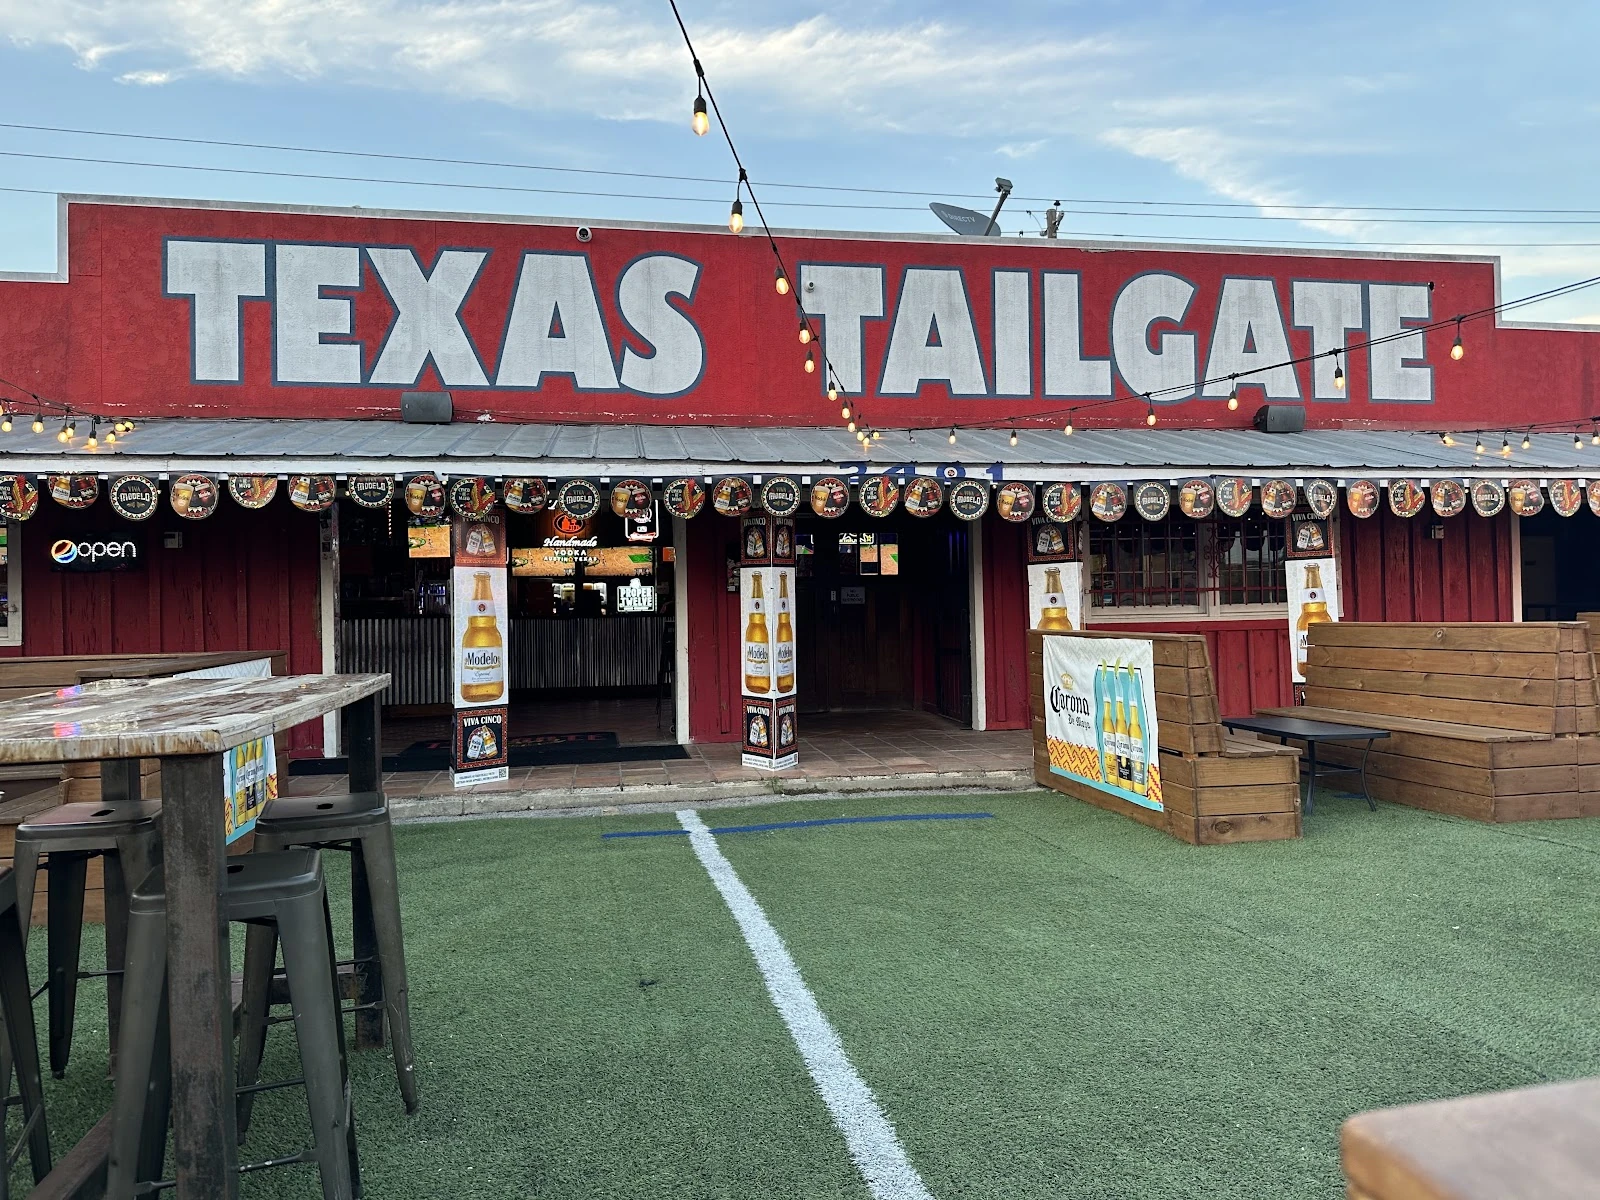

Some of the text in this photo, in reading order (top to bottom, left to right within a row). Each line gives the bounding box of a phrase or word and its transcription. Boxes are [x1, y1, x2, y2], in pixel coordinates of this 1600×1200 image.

[163, 238, 705, 396] TEXAS
[798, 261, 1435, 404] TAILGATE
[356, 482, 386, 492] MODELO
[119, 492, 150, 502] MODELO
[566, 495, 593, 504] MODELO
[768, 492, 793, 502] MODELO
[956, 495, 980, 505] MODELO
[1031, 516, 1046, 526] VIVA
[1291, 513, 1306, 522] VIVA
[543, 535, 598, 548] Handmade
[77, 541, 137, 562] open
[620, 587, 653, 598] PROPER
[619, 597, 653, 608] TWELVE
[747, 645, 769, 660] Modelo
[466, 651, 498, 666] Modelo
[1050, 684, 1090, 718] Corona
[463, 714, 502, 728] VIVA CINCO
